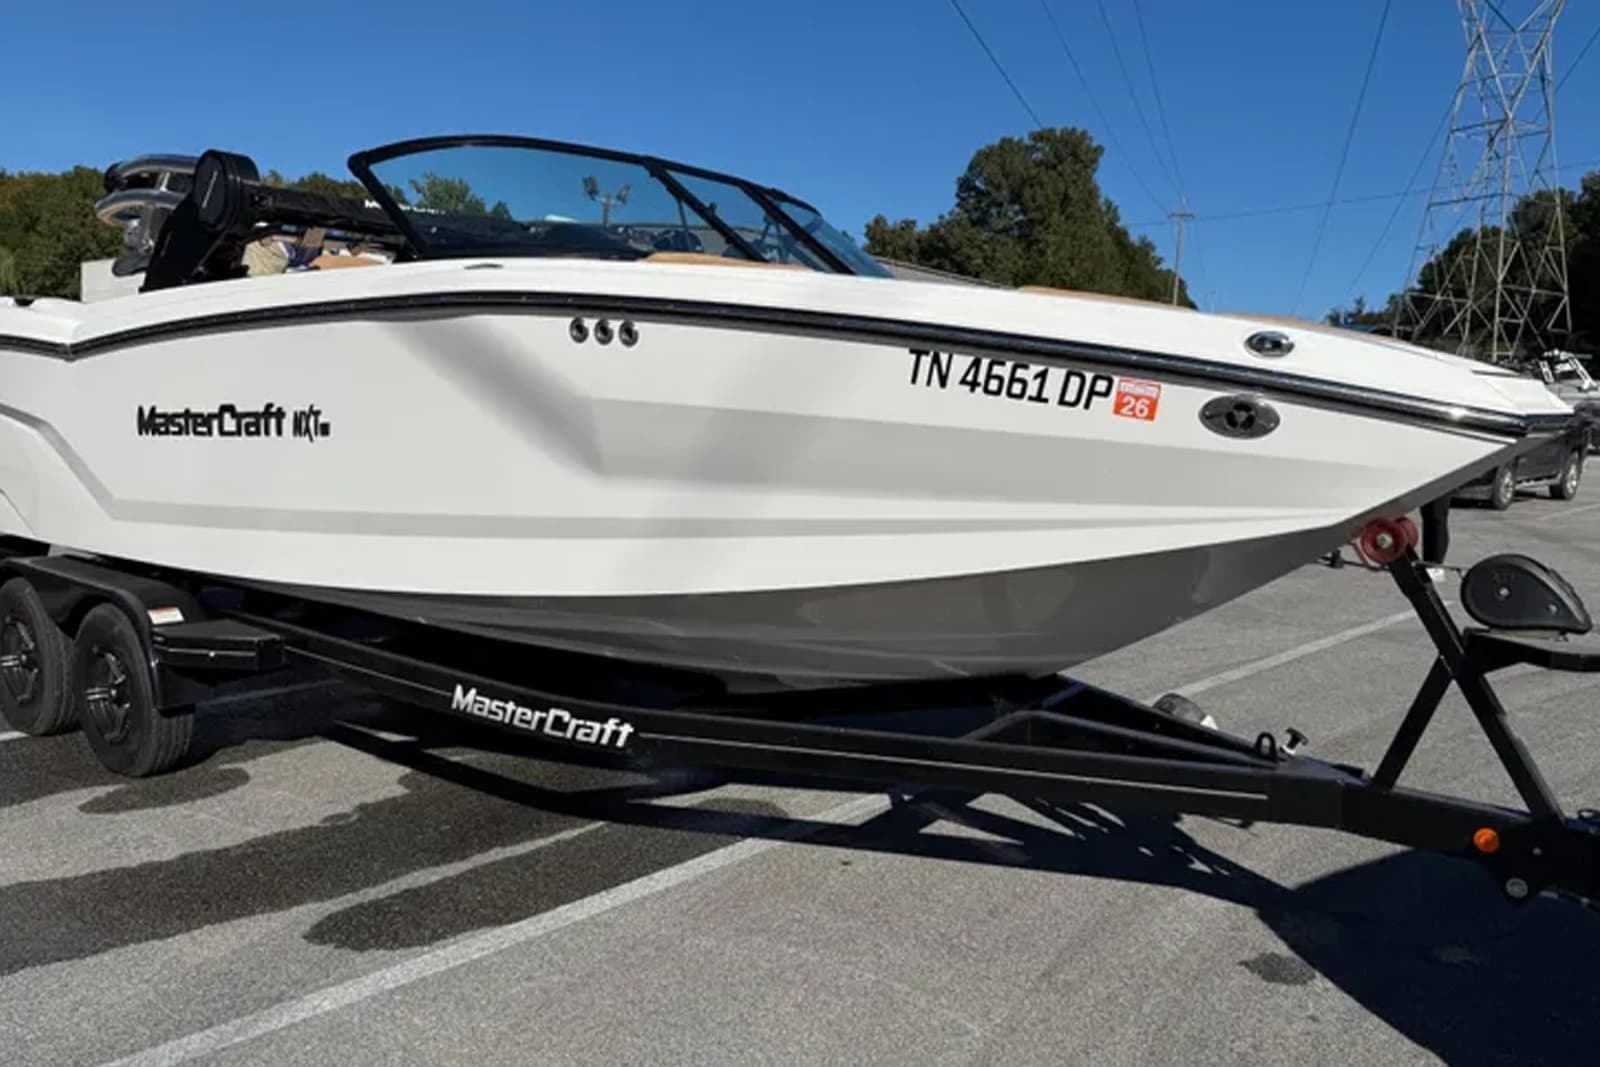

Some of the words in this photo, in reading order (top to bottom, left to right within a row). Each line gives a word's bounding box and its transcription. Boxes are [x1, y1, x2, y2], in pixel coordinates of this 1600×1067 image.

[908, 348, 953, 389] TN
[958, 357, 1050, 404] 4661
[1057, 369, 1114, 411] DP
[137, 402, 286, 437] MasterCraft
[1121, 395, 1150, 418] 26
[451, 683, 635, 748] MasterCraft
